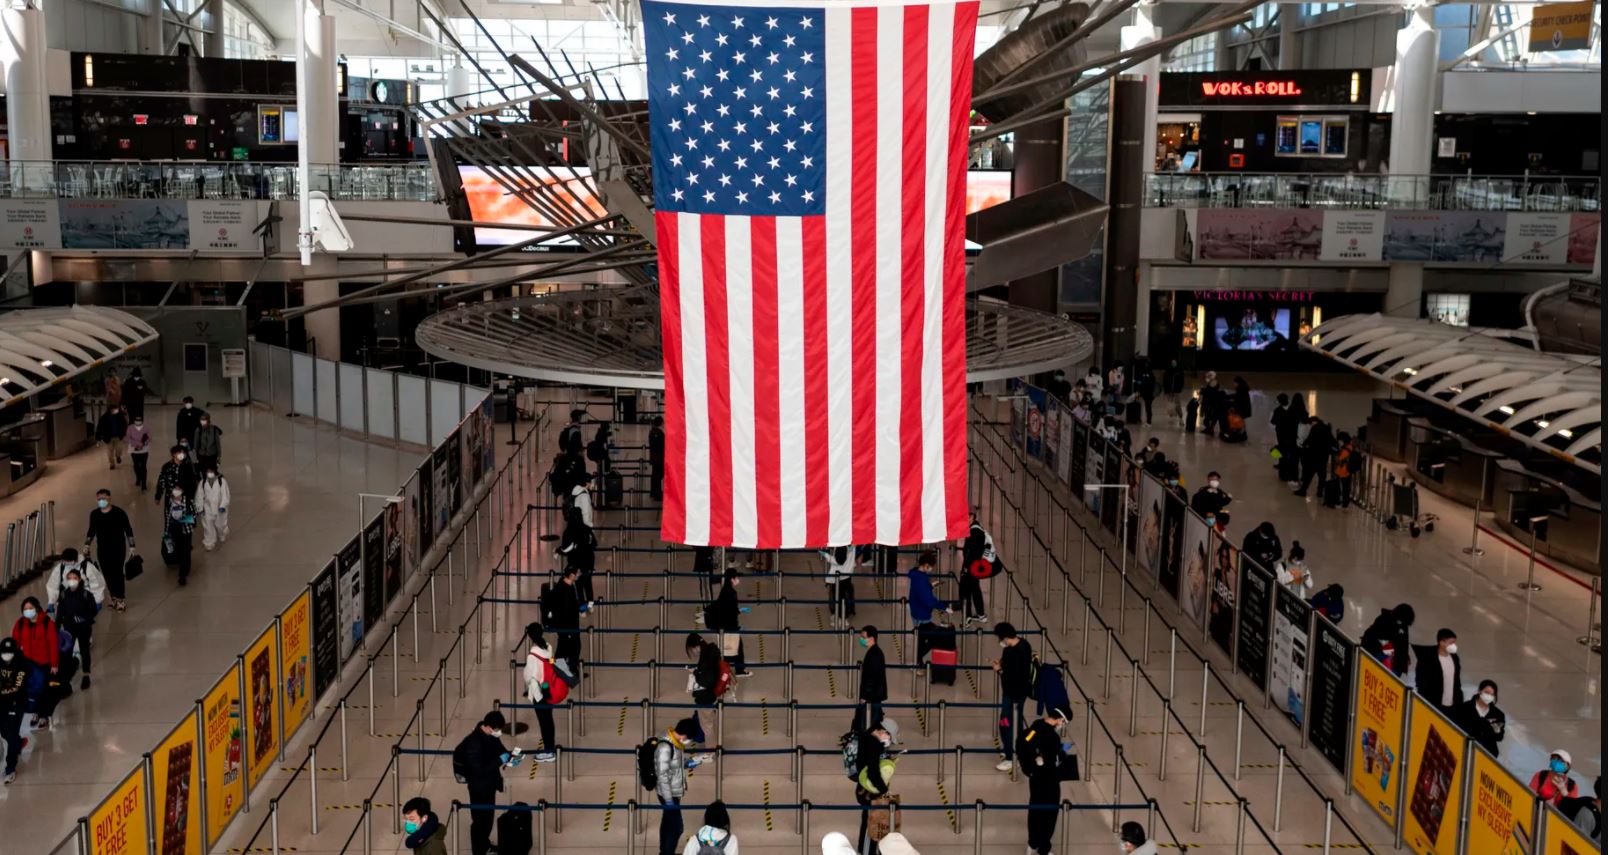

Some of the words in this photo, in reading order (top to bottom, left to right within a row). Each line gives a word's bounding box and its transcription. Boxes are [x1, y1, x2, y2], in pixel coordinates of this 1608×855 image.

[1268, 290, 1314, 302] SECRET
[1364, 669, 1379, 691] BUY
[1379, 681, 1384, 699] 3
[1384, 687, 1399, 713] GET
[1368, 692, 1386, 722] FREE
[1478, 786, 1512, 828] EXCLUSIVE
[1480, 769, 1495, 793] NOW
[1496, 782, 1512, 809] WITH
[96, 813, 113, 847] BUY
[115, 803, 121, 826] 3
[123, 785, 138, 818] GET
[1477, 803, 1486, 821] NY
[1487, 814, 1512, 841] SLEEVE
[105, 822, 127, 855] FREE
